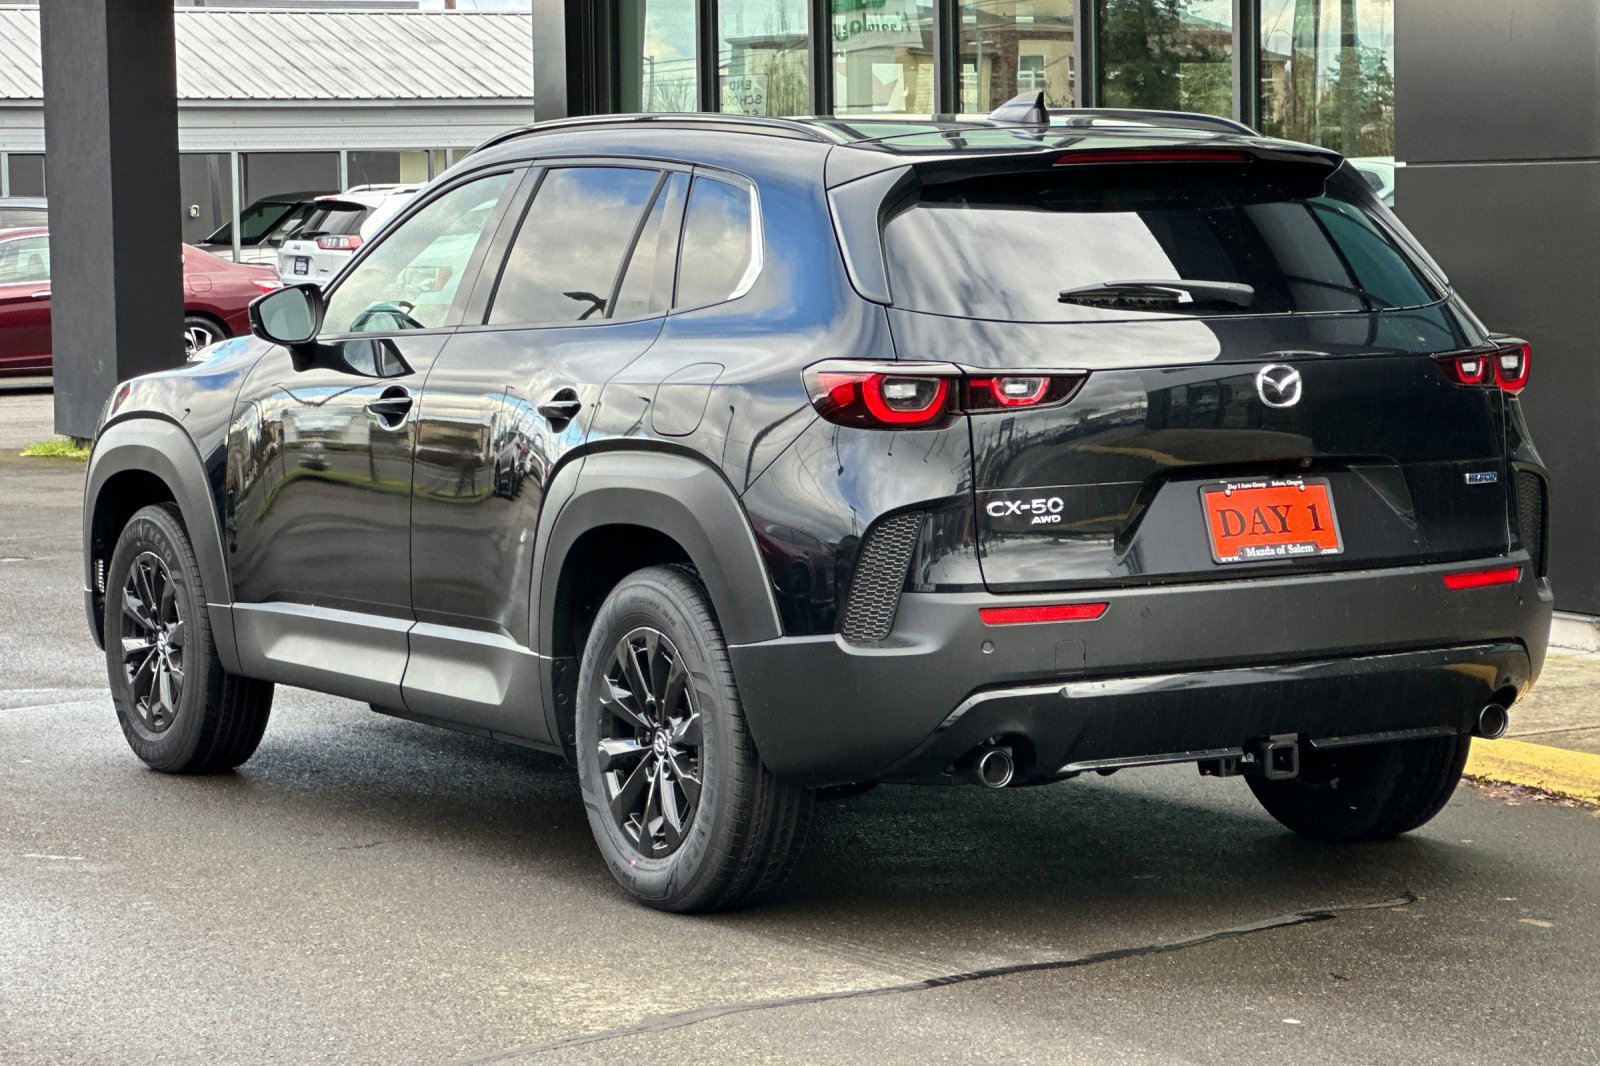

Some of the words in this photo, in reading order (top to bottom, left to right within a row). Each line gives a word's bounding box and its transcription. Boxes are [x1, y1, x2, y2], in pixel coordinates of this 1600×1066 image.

[986, 497, 1064, 517] CX-50
[1030, 514, 1062, 525] AWD
[1216, 504, 1294, 538] DAY
[1307, 503, 1325, 532] 1
[1246, 547, 1276, 557] Mazda
[1277, 546, 1286, 554] of
[1287, 544, 1314, 554] Salem
